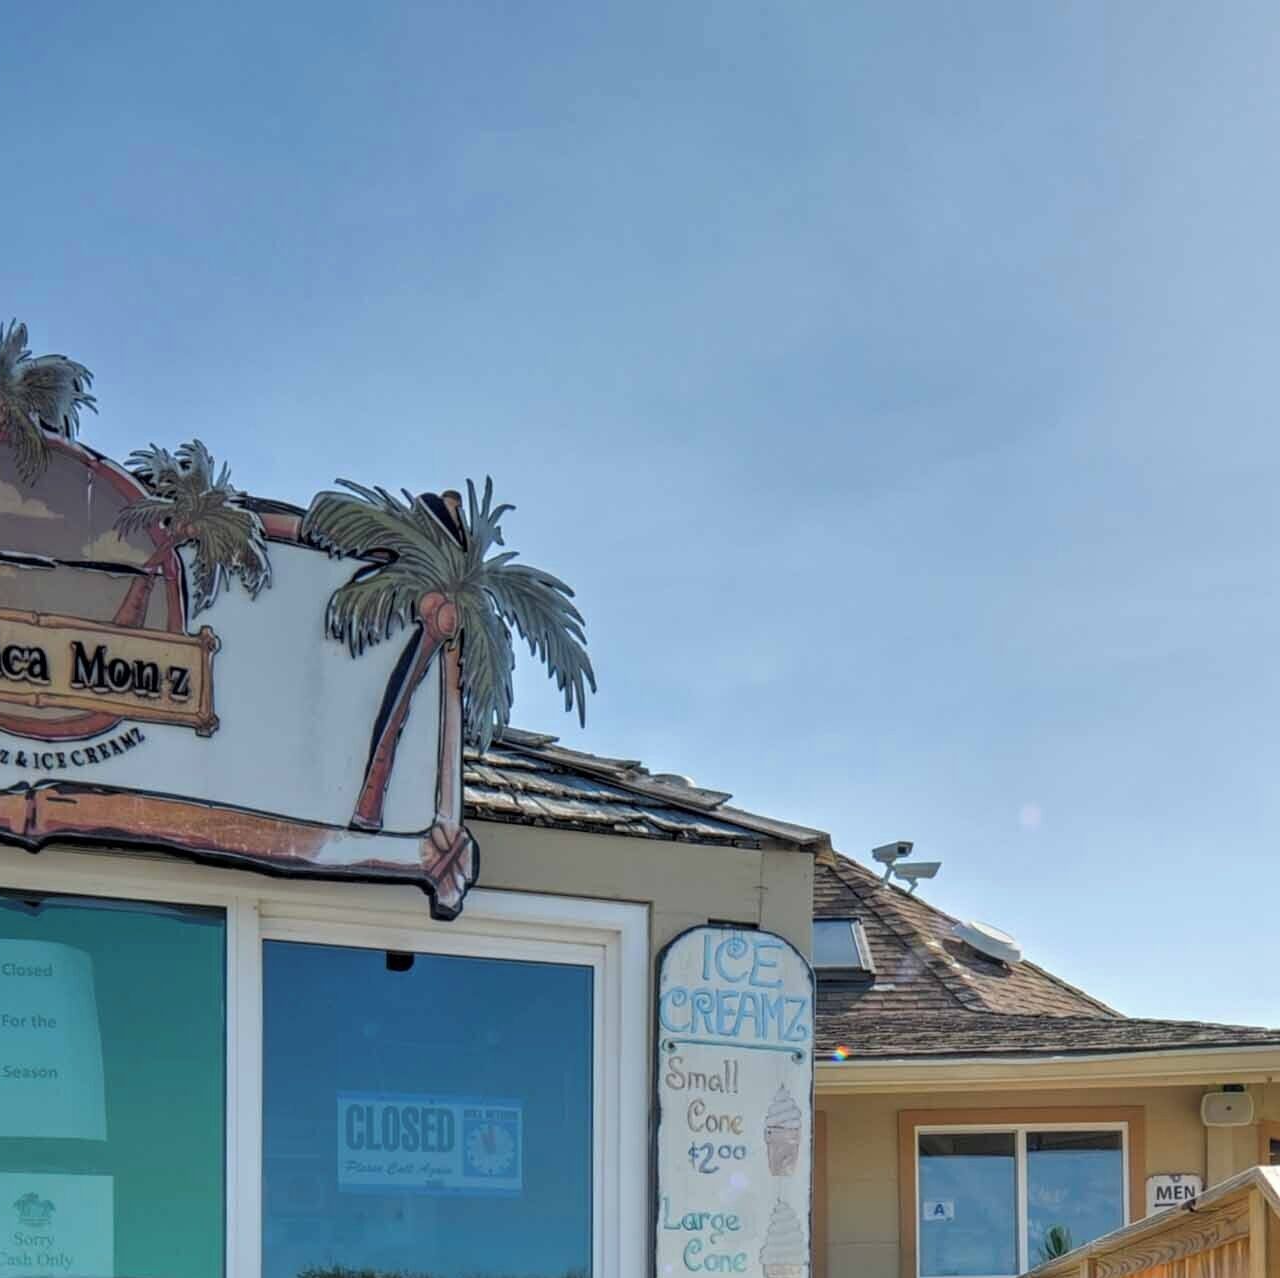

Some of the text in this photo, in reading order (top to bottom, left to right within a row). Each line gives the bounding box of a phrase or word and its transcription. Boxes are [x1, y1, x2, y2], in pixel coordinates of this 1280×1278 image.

[15, 750, 28, 768] &
[33, 752, 67, 770] ICE
[71, 726, 146, 766] CREAMZ
[1, 962, 53, 978] Closed
[702, 933, 785, 989] ICE
[1, 1014, 57, 1029] For the
[659, 986, 809, 1043] CREAMZ
[2, 1065, 58, 1080] Season
[665, 1055, 739, 1094] Small
[345, 1103, 456, 1153] CLOSED
[687, 1099, 744, 1135] Cone
[933, 1203, 945, 1217] A
[1155, 1185, 1196, 1201] MEN
[662, 1197, 741, 1245] Large
[13, 1231, 55, 1250] Sorry
[683, 1238, 748, 1273] Cone
[37, 1252, 74, 1272] Only
